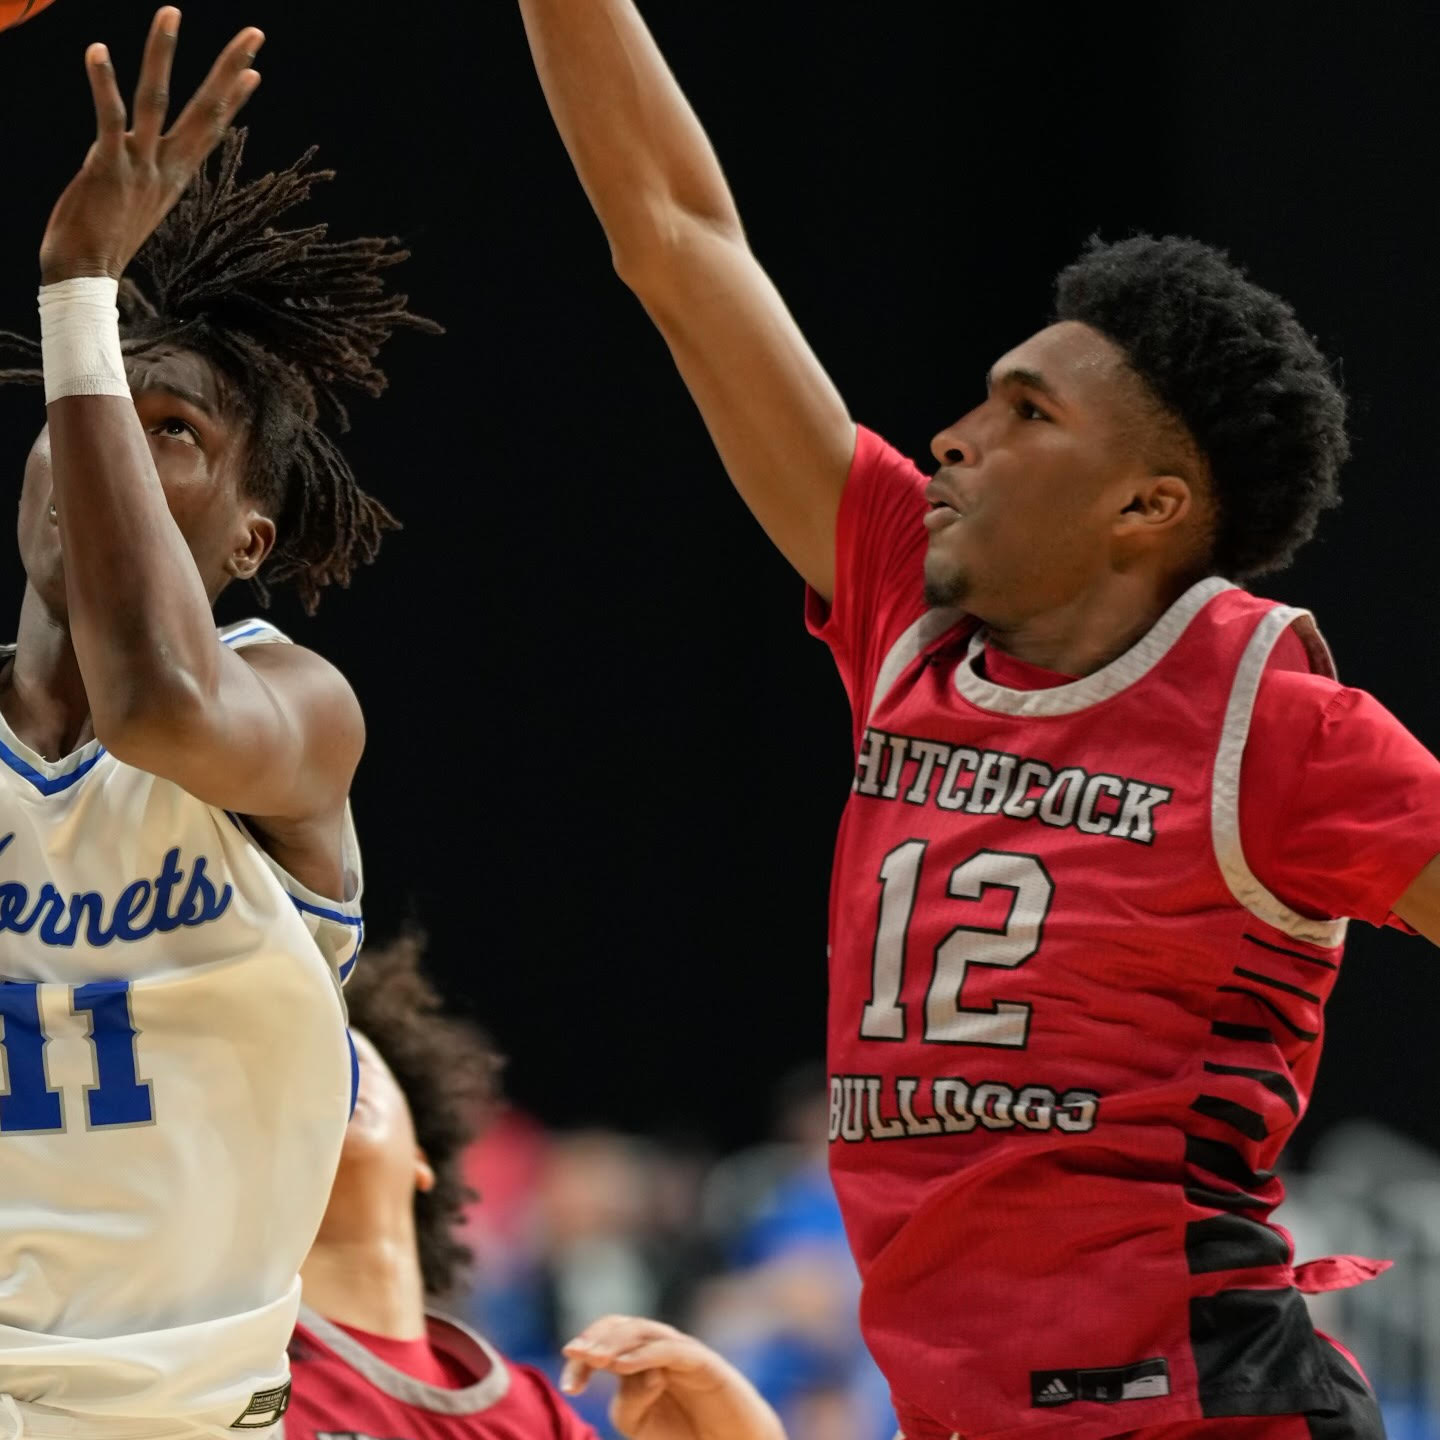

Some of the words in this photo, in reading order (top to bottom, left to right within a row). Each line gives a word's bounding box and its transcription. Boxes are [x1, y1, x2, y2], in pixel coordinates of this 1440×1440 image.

[852, 726, 1174, 846] HITCHCOCK
[859, 837, 1056, 1050] 12
[828, 1074, 1100, 1143] BULLDOGS
